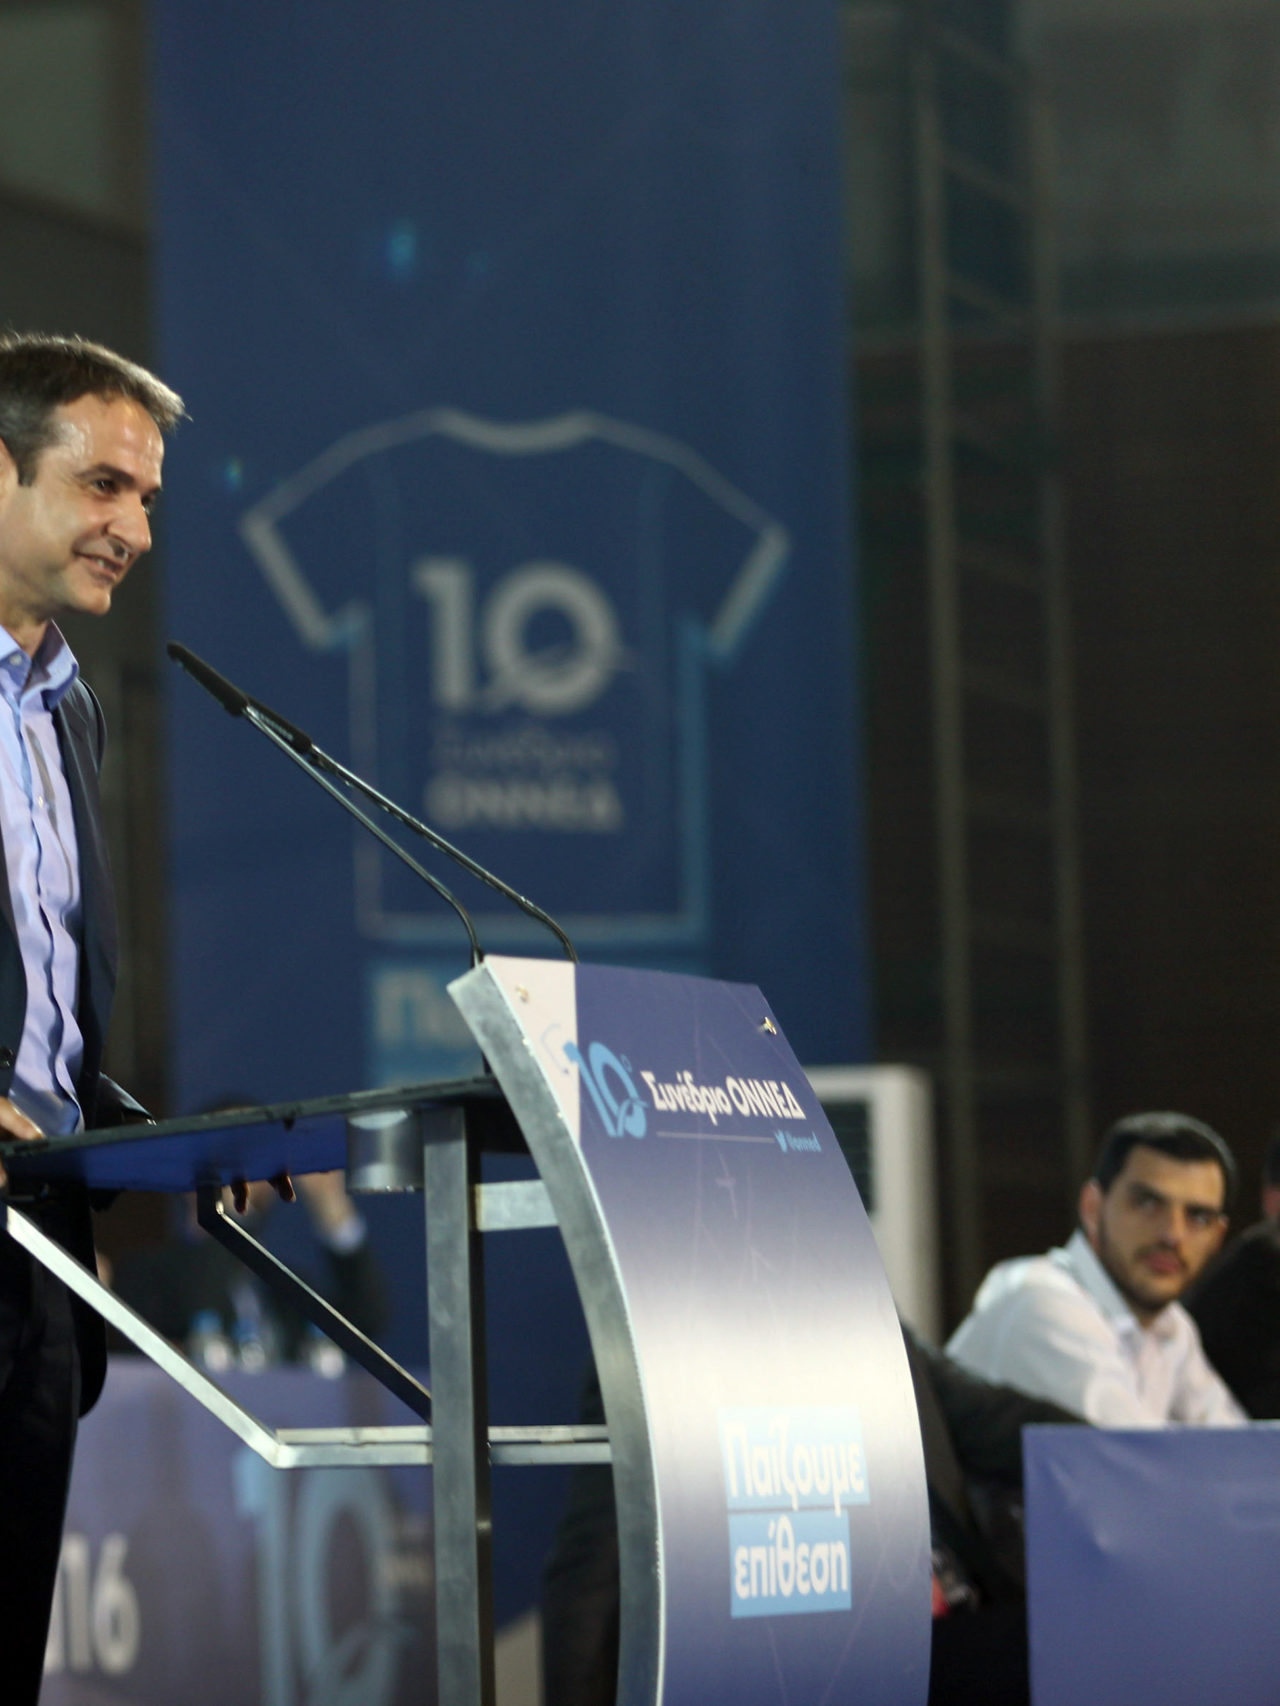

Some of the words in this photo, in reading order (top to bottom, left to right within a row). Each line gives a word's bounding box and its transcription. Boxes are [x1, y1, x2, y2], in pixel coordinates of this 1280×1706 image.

[640, 1069, 732, 1126] Συνέδριο
[726, 1076, 807, 1120] ΟΝΝΕΔ
[723, 1416, 865, 1518] Παίζουμε
[735, 1514, 849, 1599] επίθεση
